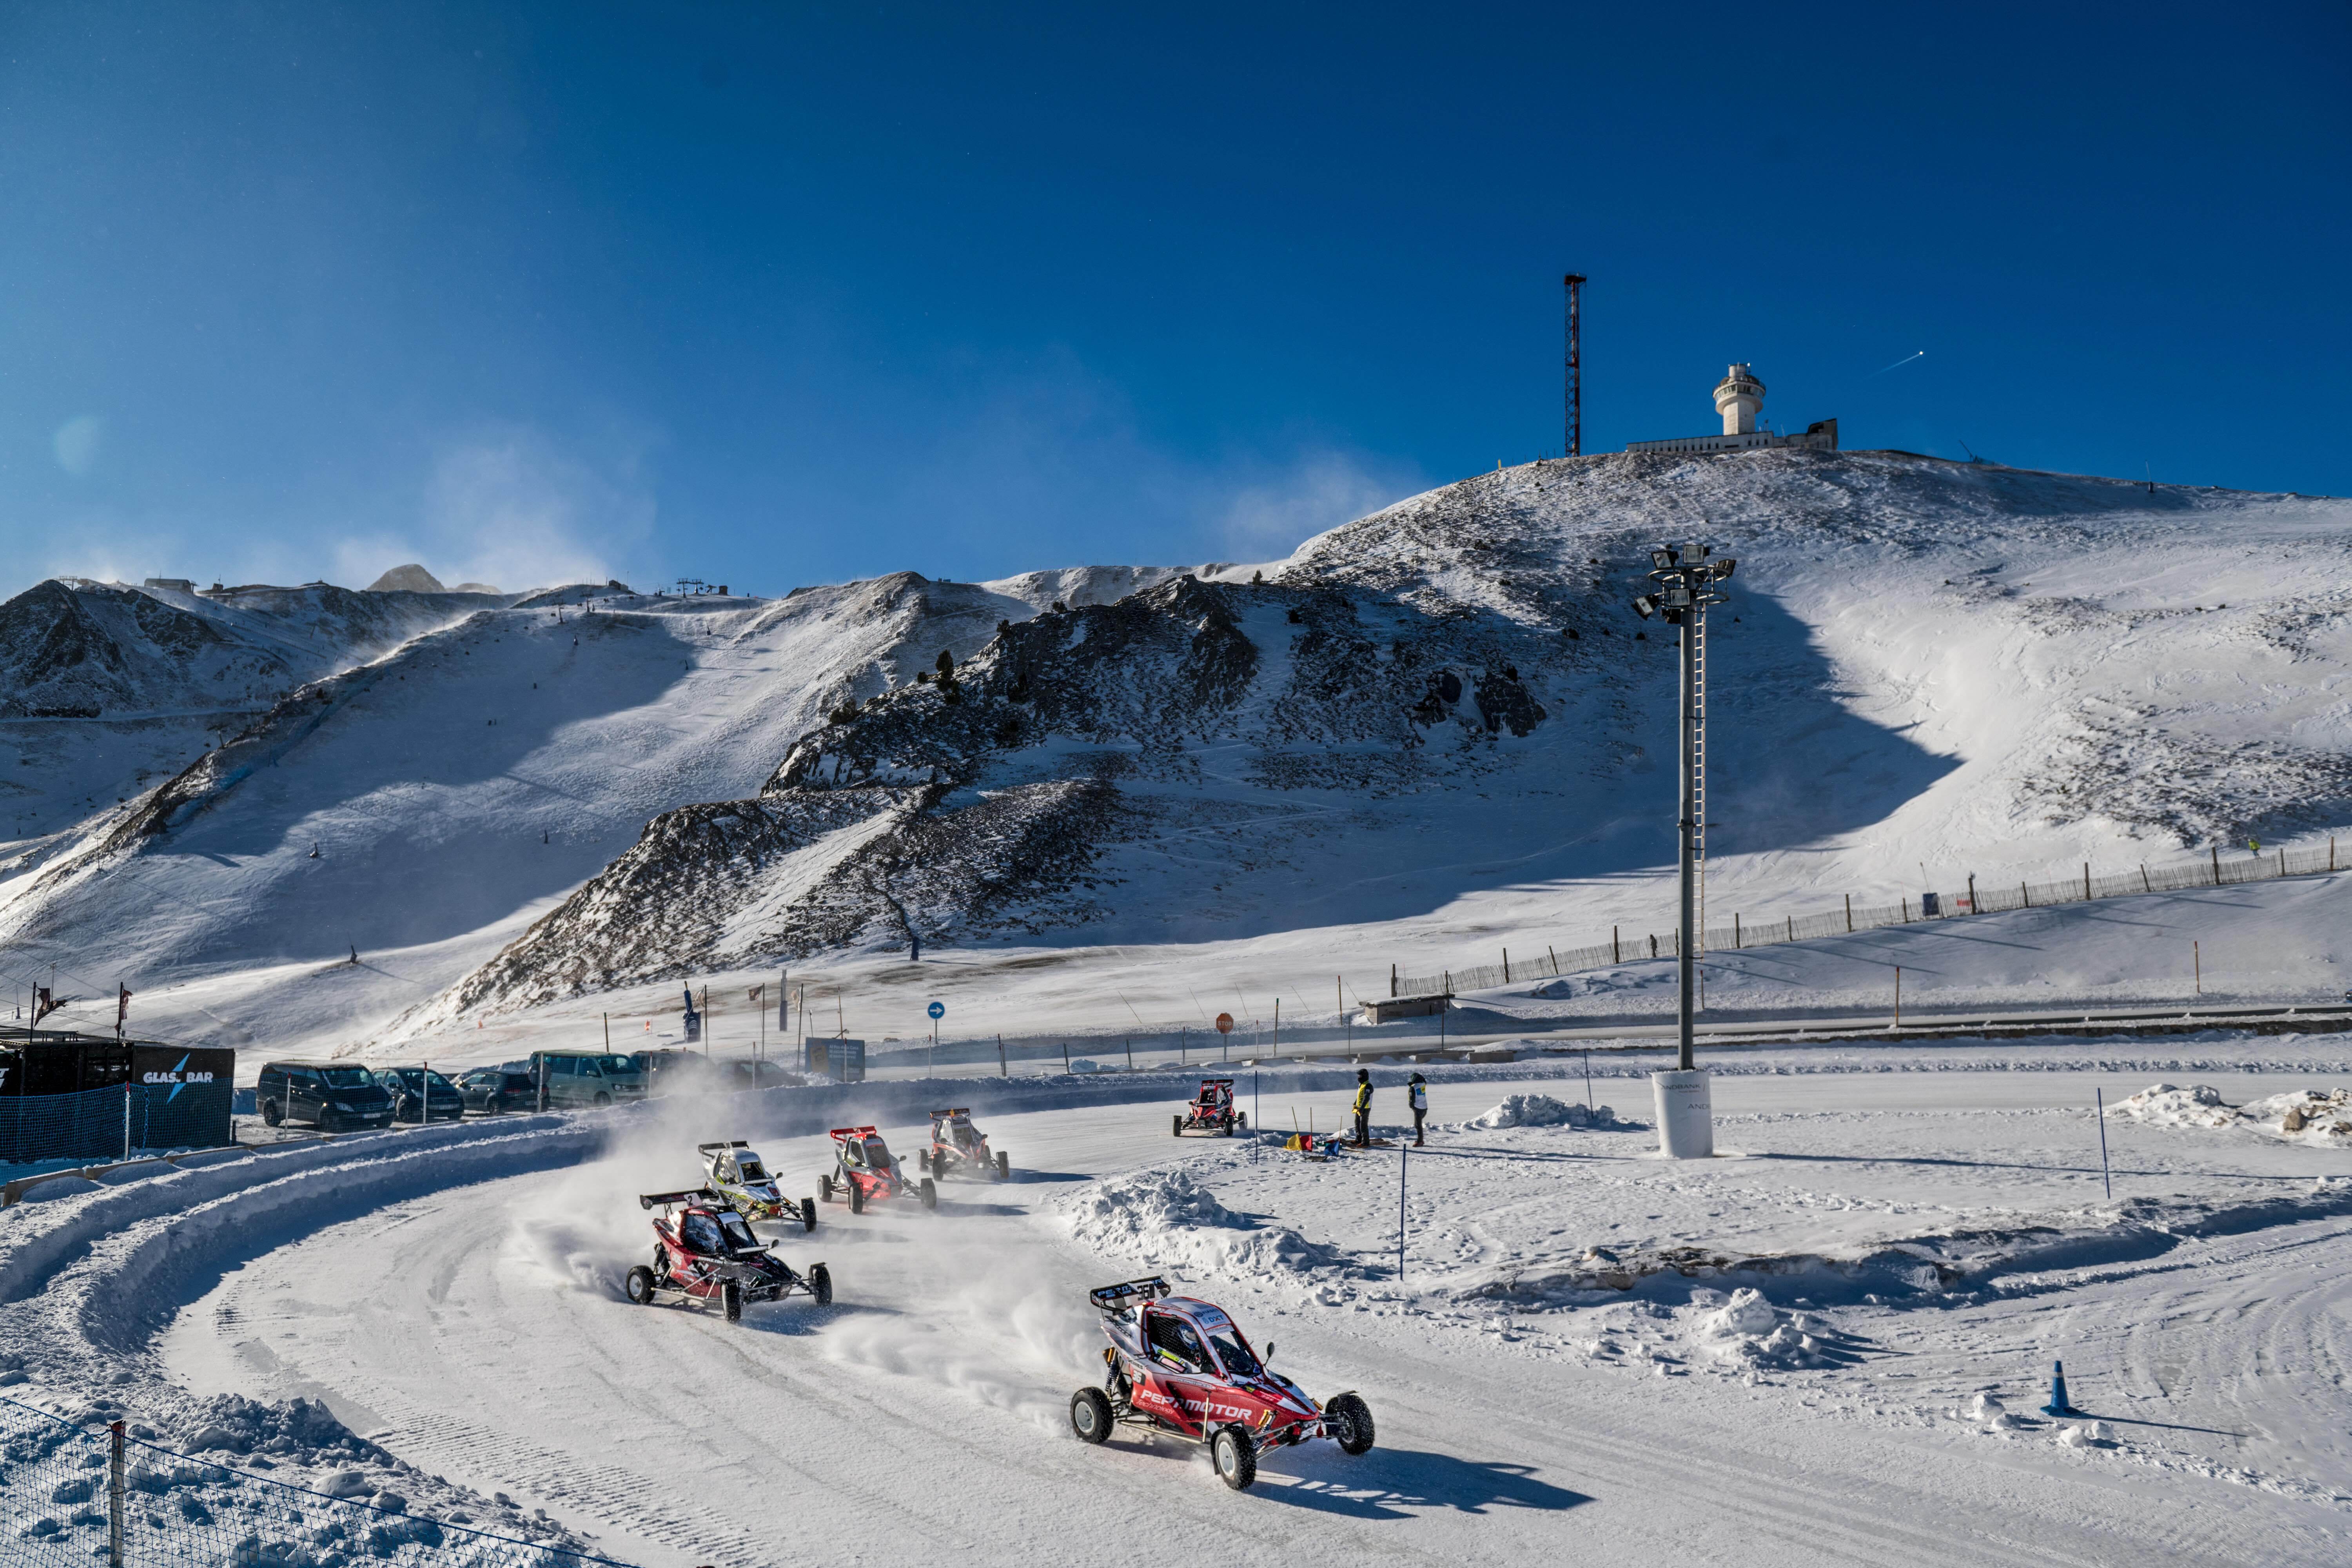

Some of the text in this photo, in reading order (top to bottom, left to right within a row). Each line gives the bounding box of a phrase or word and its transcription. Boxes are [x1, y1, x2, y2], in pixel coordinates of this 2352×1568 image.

[187, 1072, 213, 1083] BAR
[688, 1196, 693, 1205] 2
[1132, 1369, 1142, 1384] 36
[1136, 1398, 1174, 1414] Technology
